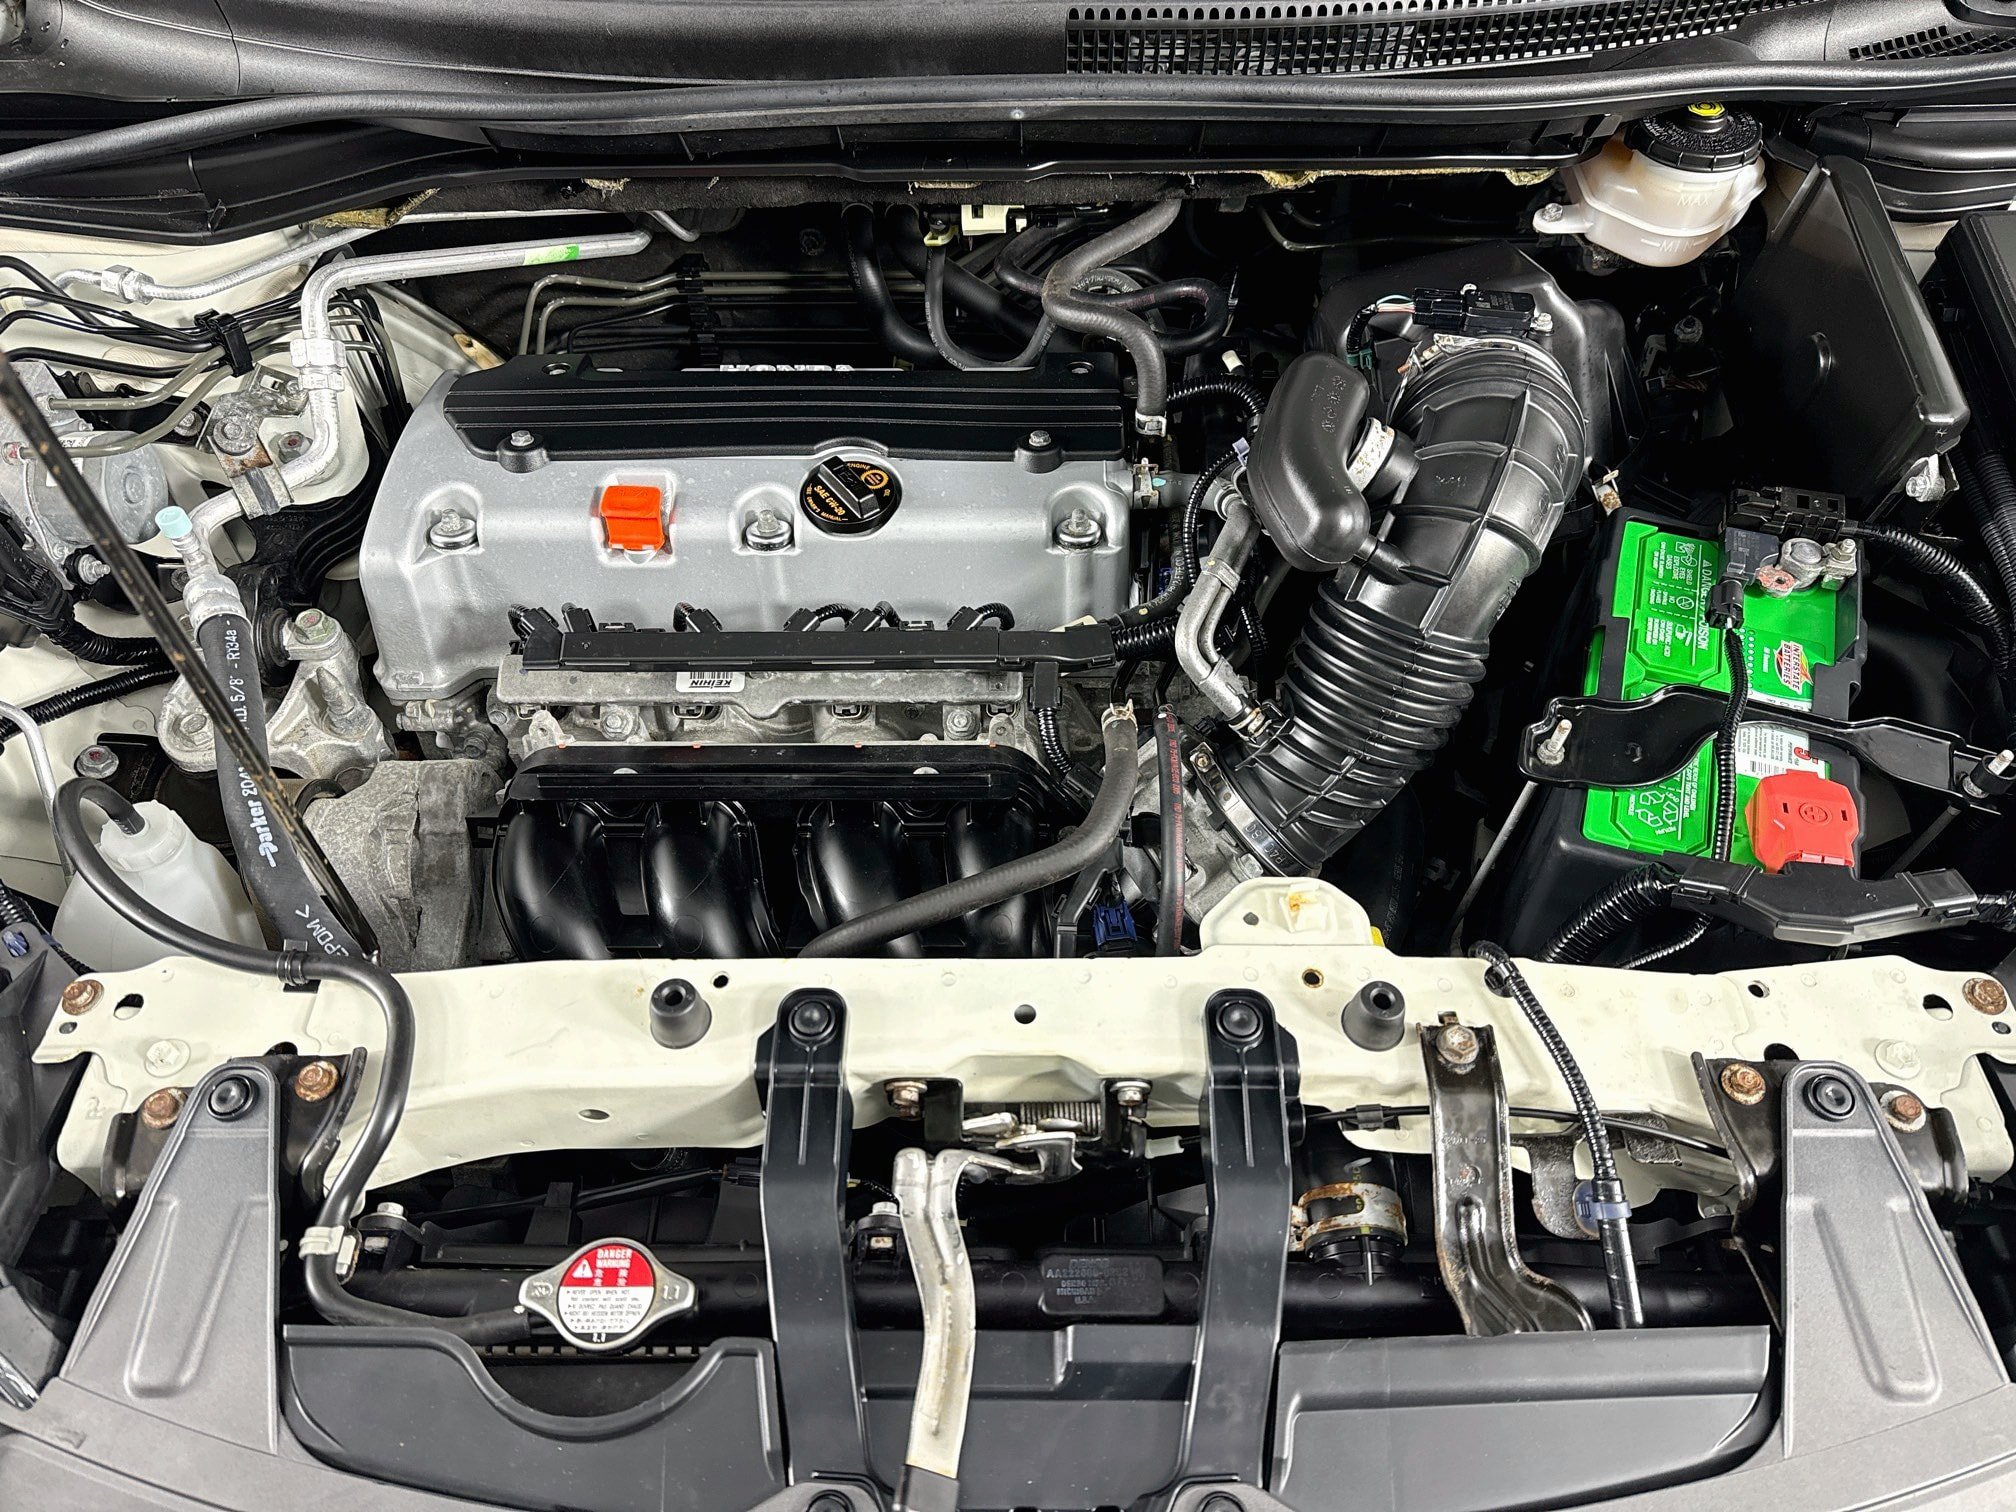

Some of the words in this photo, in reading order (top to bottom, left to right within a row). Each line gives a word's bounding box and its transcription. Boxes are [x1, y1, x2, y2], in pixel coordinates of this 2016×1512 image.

[1677, 194, 1712, 207] MAX
[1659, 239, 1695, 252] MIN
[814, 485, 830, 499] SAE
[225, 629, 240, 660] R134a
[1783, 643, 1791, 684] BATTERIES
[248, 800, 279, 868] Parker
[597, 1249, 633, 1259] DANGER
